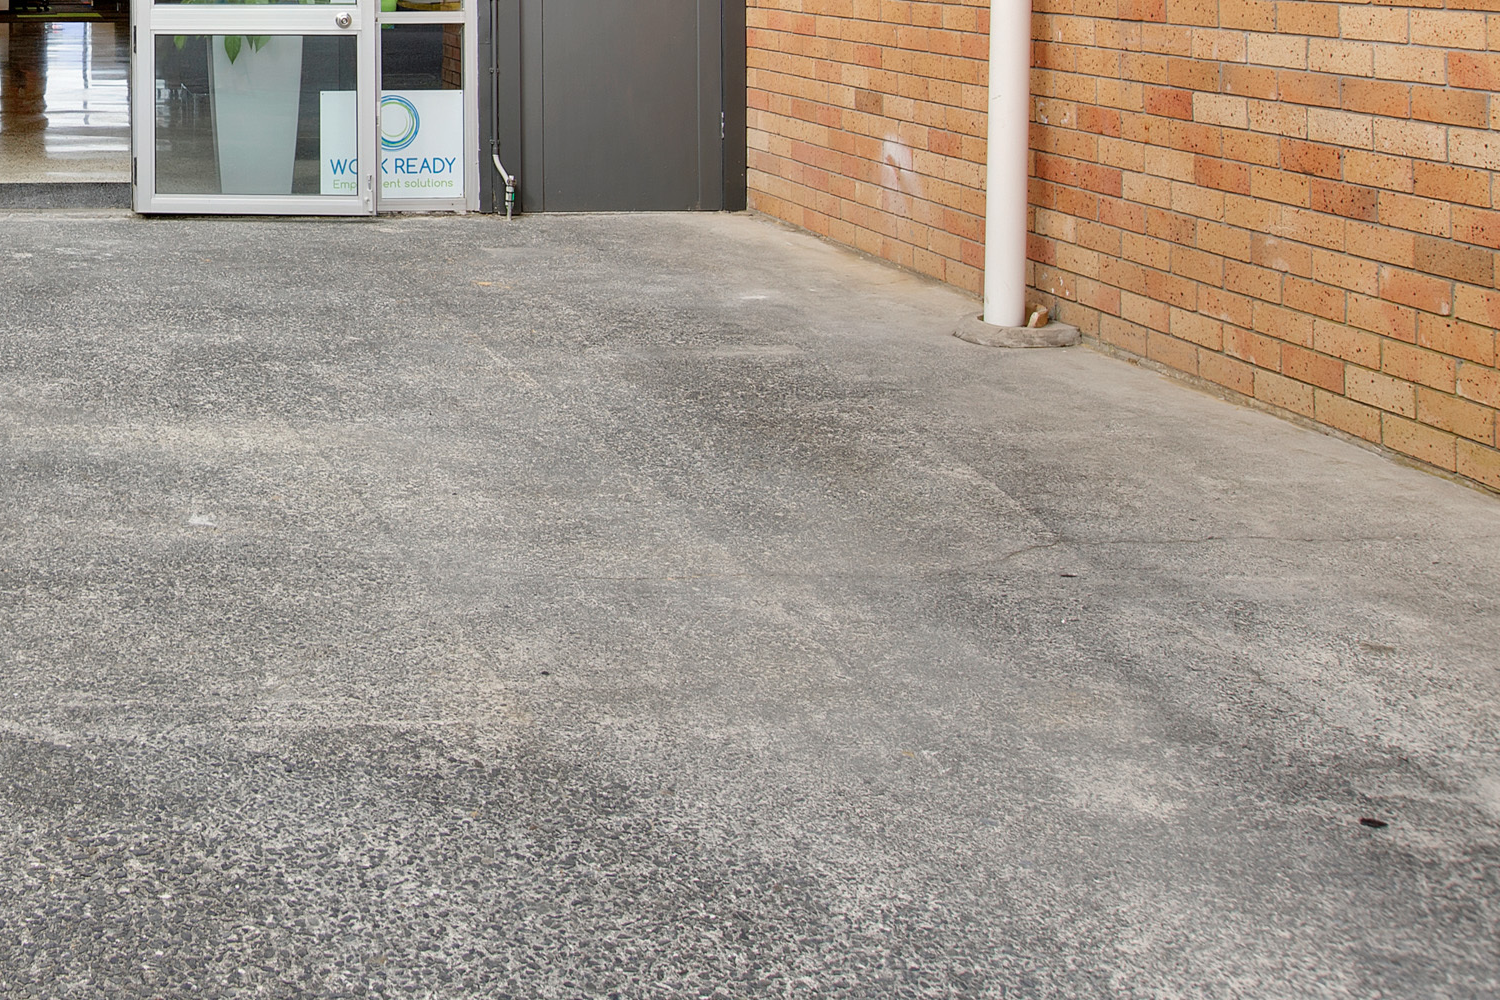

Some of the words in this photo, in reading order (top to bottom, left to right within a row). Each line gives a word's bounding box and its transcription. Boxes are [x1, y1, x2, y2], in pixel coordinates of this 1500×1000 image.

[330, 158, 388, 175] WOK
[395, 157, 456, 174] READY
[333, 179, 400, 190] Empent
[404, 178, 454, 188] solutions
